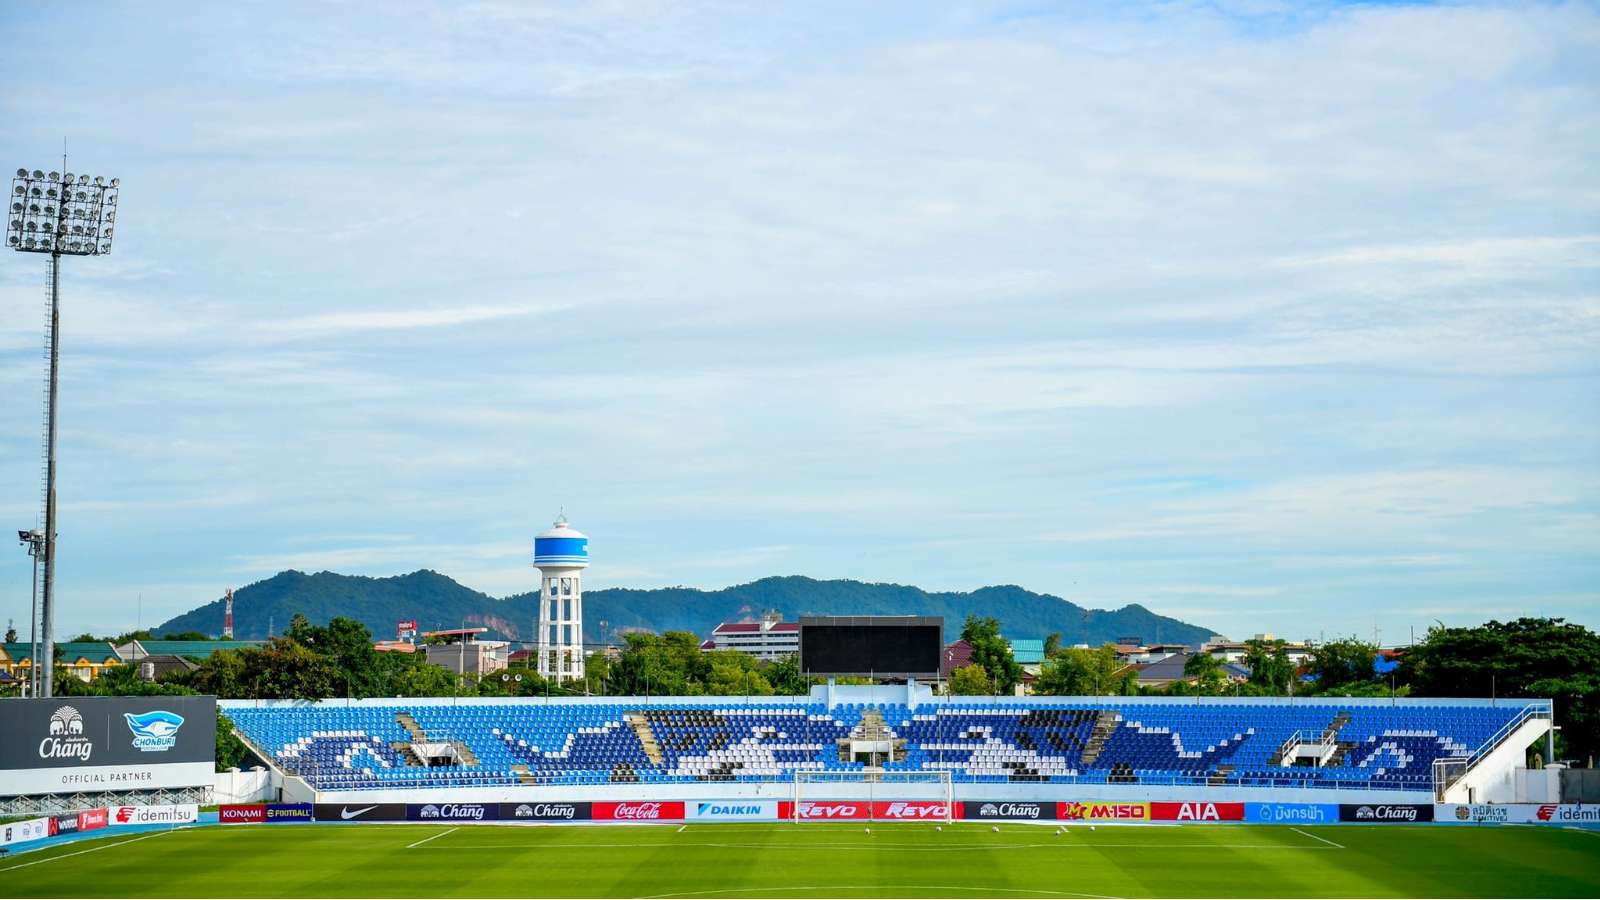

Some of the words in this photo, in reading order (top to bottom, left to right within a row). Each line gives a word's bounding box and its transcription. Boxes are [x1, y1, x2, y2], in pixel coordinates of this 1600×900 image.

[39, 737, 92, 761] Chang
[134, 737, 176, 748] CHONBURI
[62, 774, 105, 784] OFFICIAL
[110, 772, 152, 782] PARTNER
[137, 808, 191, 822] idemitsu
[223, 809, 262, 818] KONAMI
[441, 804, 485, 820] Chang
[534, 804, 575, 819] Chang
[614, 802, 662, 819] Coca-Cola
[711, 806, 761, 815] DAIKIN
[792, 802, 857, 818] REVO
[885, 802, 948, 818] REVO
[1000, 803, 1041, 819] Chang
[1090, 805, 1145, 818] M-150
[1177, 803, 1220, 820] AIA
[1275, 805, 1325, 821] มังกรฟ้า
[1375, 806, 1418, 820] Chang
